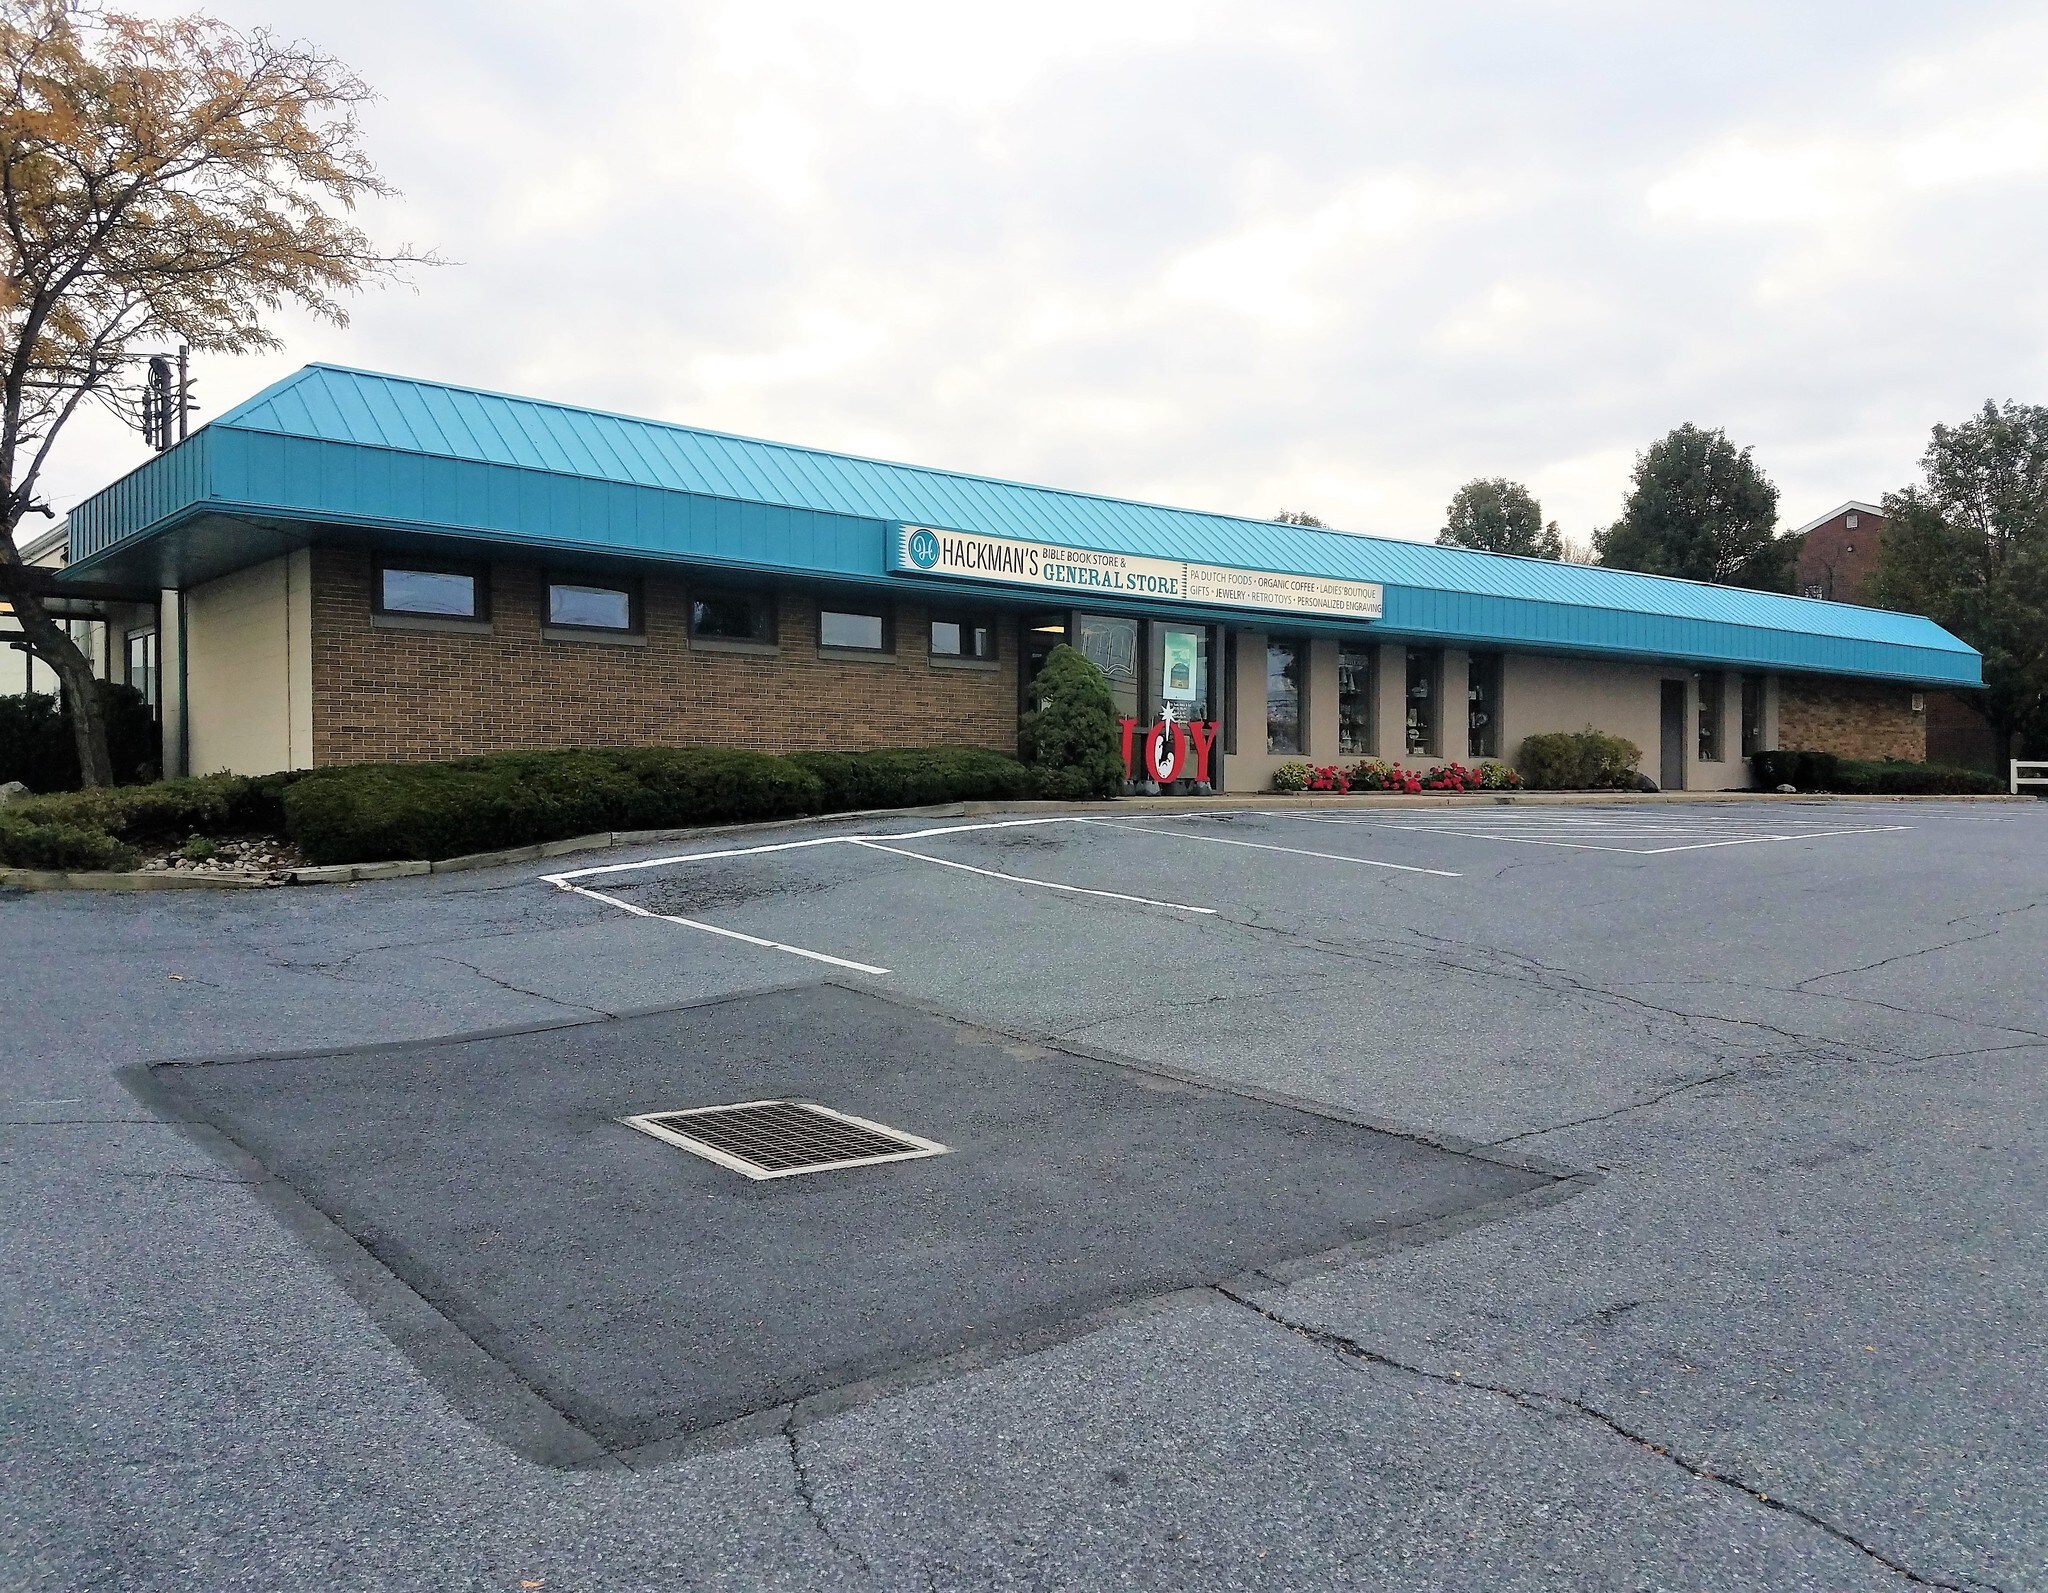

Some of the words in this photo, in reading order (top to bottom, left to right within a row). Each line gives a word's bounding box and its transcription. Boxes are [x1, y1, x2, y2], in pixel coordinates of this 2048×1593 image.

[943, 538, 1038, 576] HACKMAN'S
[1042, 548, 1065, 561] BIBLE
[1067, 551, 1091, 564] BOOK
[1092, 554, 1118, 567] STORE
[1120, 557, 1127, 568] &
[1043, 564, 1123, 589] GENERAL
[1126, 573, 1178, 595] STORE
[1190, 569, 1199, 580] PA
[1201, 571, 1225, 583] DUTCH
[1228, 574, 1252, 586] FOODS
[1258, 577, 1289, 590] ORGANIC
[1290, 581, 1315, 593] COFFEE
[1190, 585, 1210, 597] GIFTS
[1215, 589, 1246, 601] JEWELRY
[1251, 593, 1274, 604] RETRO
[1275, 595, 1292, 605] TOYS
[1297, 596, 1345, 610] PERSONALIZED
[1345, 601, 1382, 613] ENGRAVING
